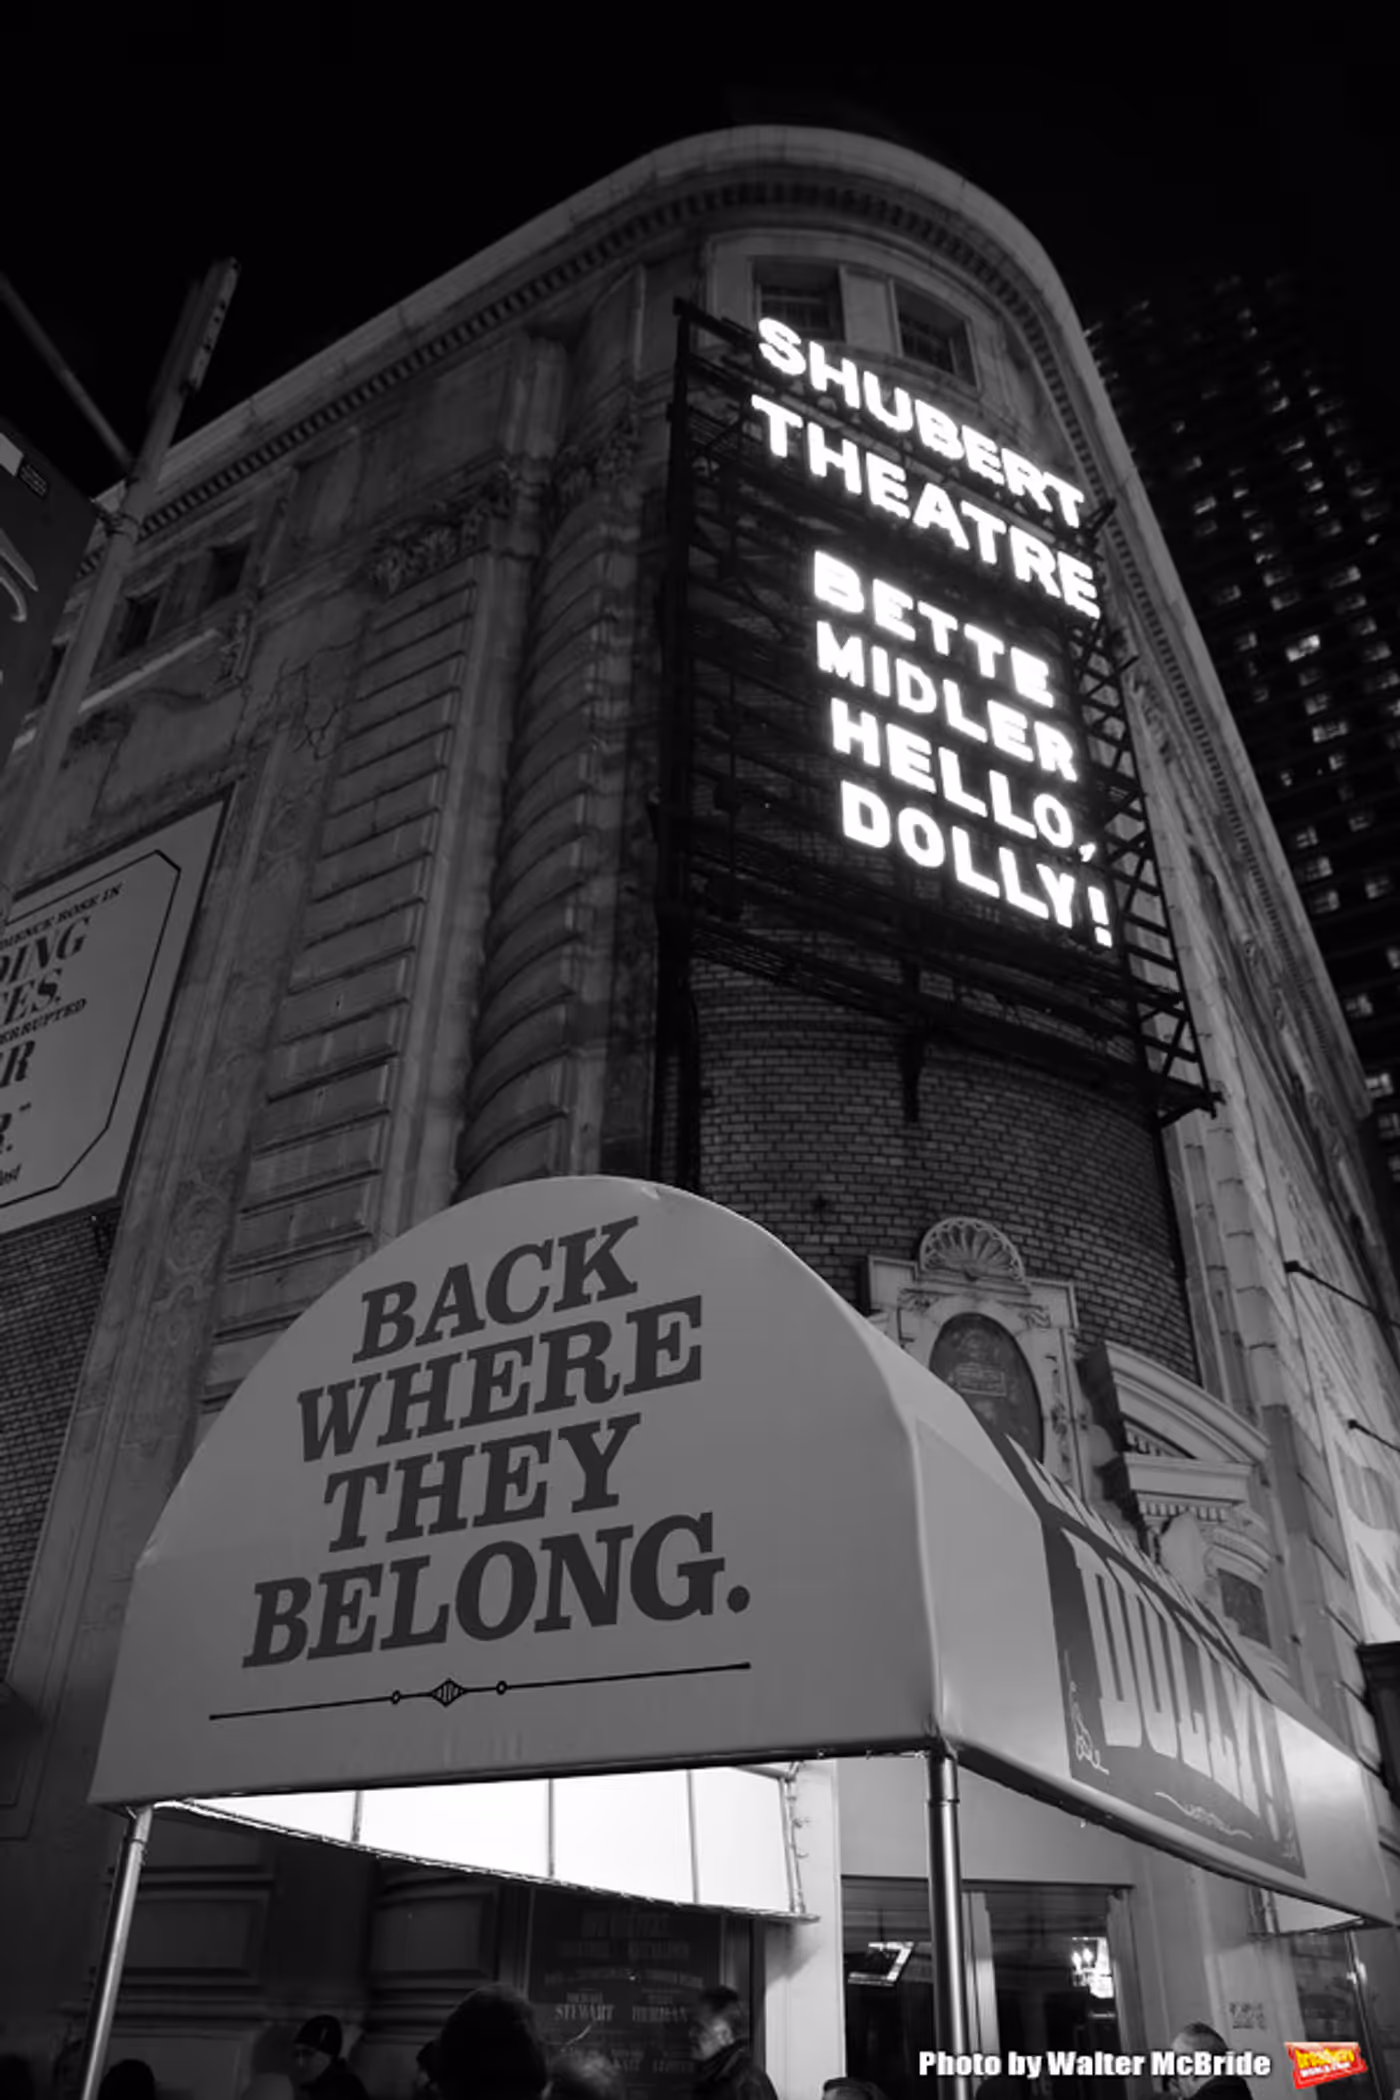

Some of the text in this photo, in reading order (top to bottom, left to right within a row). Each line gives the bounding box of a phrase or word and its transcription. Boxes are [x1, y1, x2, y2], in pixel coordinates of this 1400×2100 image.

[757, 317, 1085, 528] SHUBERT
[751, 394, 1100, 619] THEATRE
[813, 550, 1054, 708] BETTE
[816, 620, 1078, 782] MIDLER
[830, 698, 1097, 863] HELLO,
[102, 882, 123, 904] IN
[841, 780, 1113, 948] DOLLY!
[351, 1216, 639, 1364] BACK
[297, 1295, 702, 1463] WHERE
[323, 1412, 641, 1553] THEY
[241, 1511, 751, 1669] BELONG.
